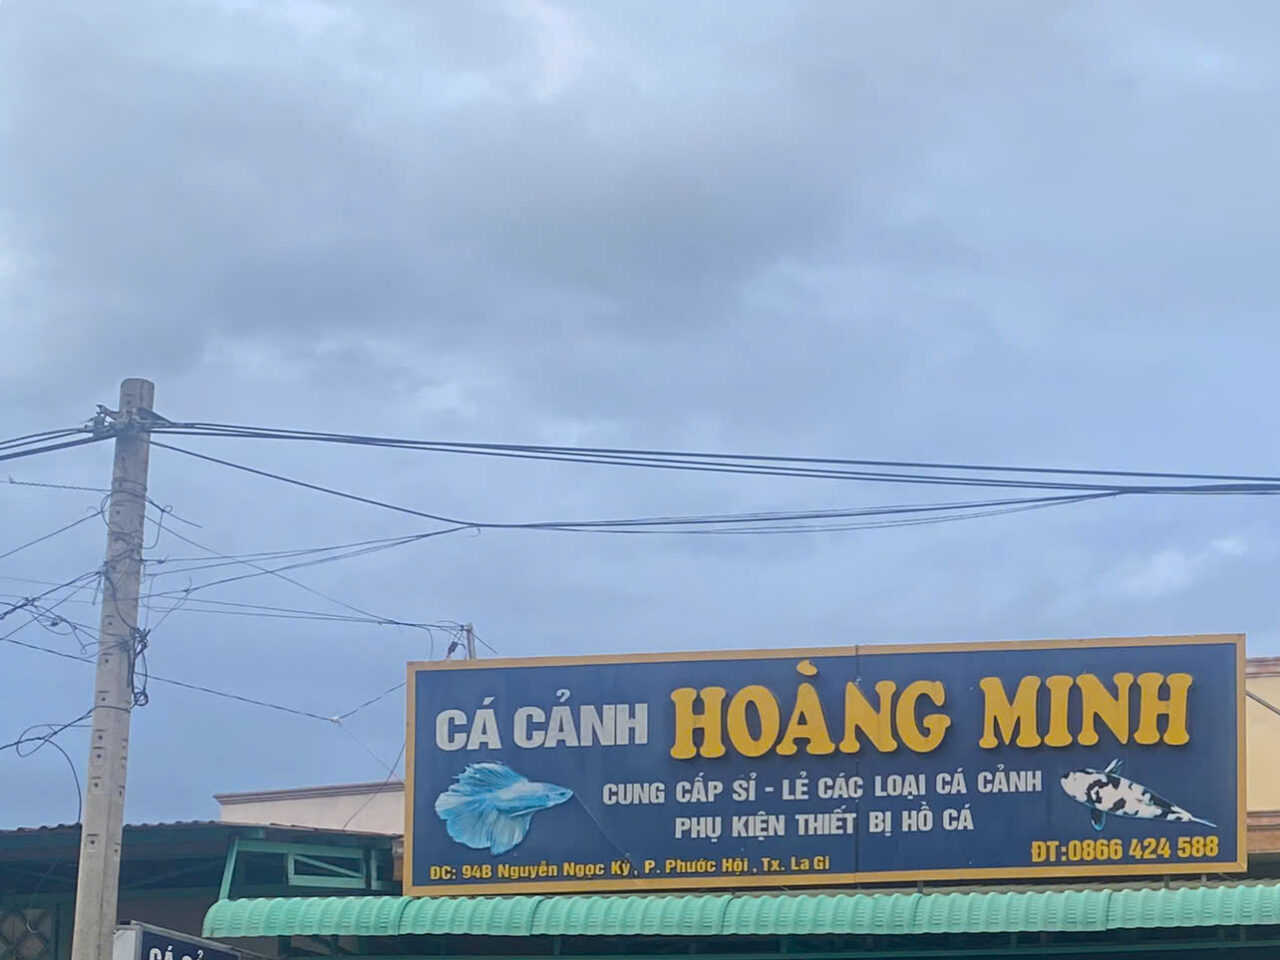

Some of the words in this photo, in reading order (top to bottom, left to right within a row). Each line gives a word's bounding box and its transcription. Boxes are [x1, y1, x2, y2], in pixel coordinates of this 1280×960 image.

[435, 697, 502, 751] CÁ
[513, 689, 648, 748] CẢNH
[670, 659, 951, 759] HOÀNG
[979, 672, 1193, 748] MINH
[603, 782, 665, 805] CUNG
[676, 774, 723, 802] CẤP
[734, 772, 756, 801] SỈ
[783, 771, 808, 800] LẺ
[818, 772, 863, 798] CÁC
[875, 775, 925, 800] LOẠI
[936, 768, 967, 794] CÁ
[977, 764, 1042, 793] CẢNH
[676, 817, 721, 842] PHỤ
[732, 812, 784, 840] KIỆN
[795, 805, 856, 836] THIẾT
[869, 812, 891, 836] BỊ
[902, 802, 933, 832] HỒ
[943, 804, 973, 830] CÁ
[430, 866, 456, 880] ĐC:
[462, 864, 492, 879] 94B
[498, 861, 558, 879] Nguyễn
[563, 862, 604, 879] Ngọc
[644, 860, 660, 874] P.
[665, 858, 716, 873] Phước
[722, 857, 748, 874] Hội
[761, 858, 785, 871] Tx.
[791, 857, 809, 870] La
[814, 856, 830, 870] Gi
[1031, 839, 1122, 862] ĐT:0866
[1128, 838, 1171, 860] 424
[1177, 836, 1219, 857] 588
